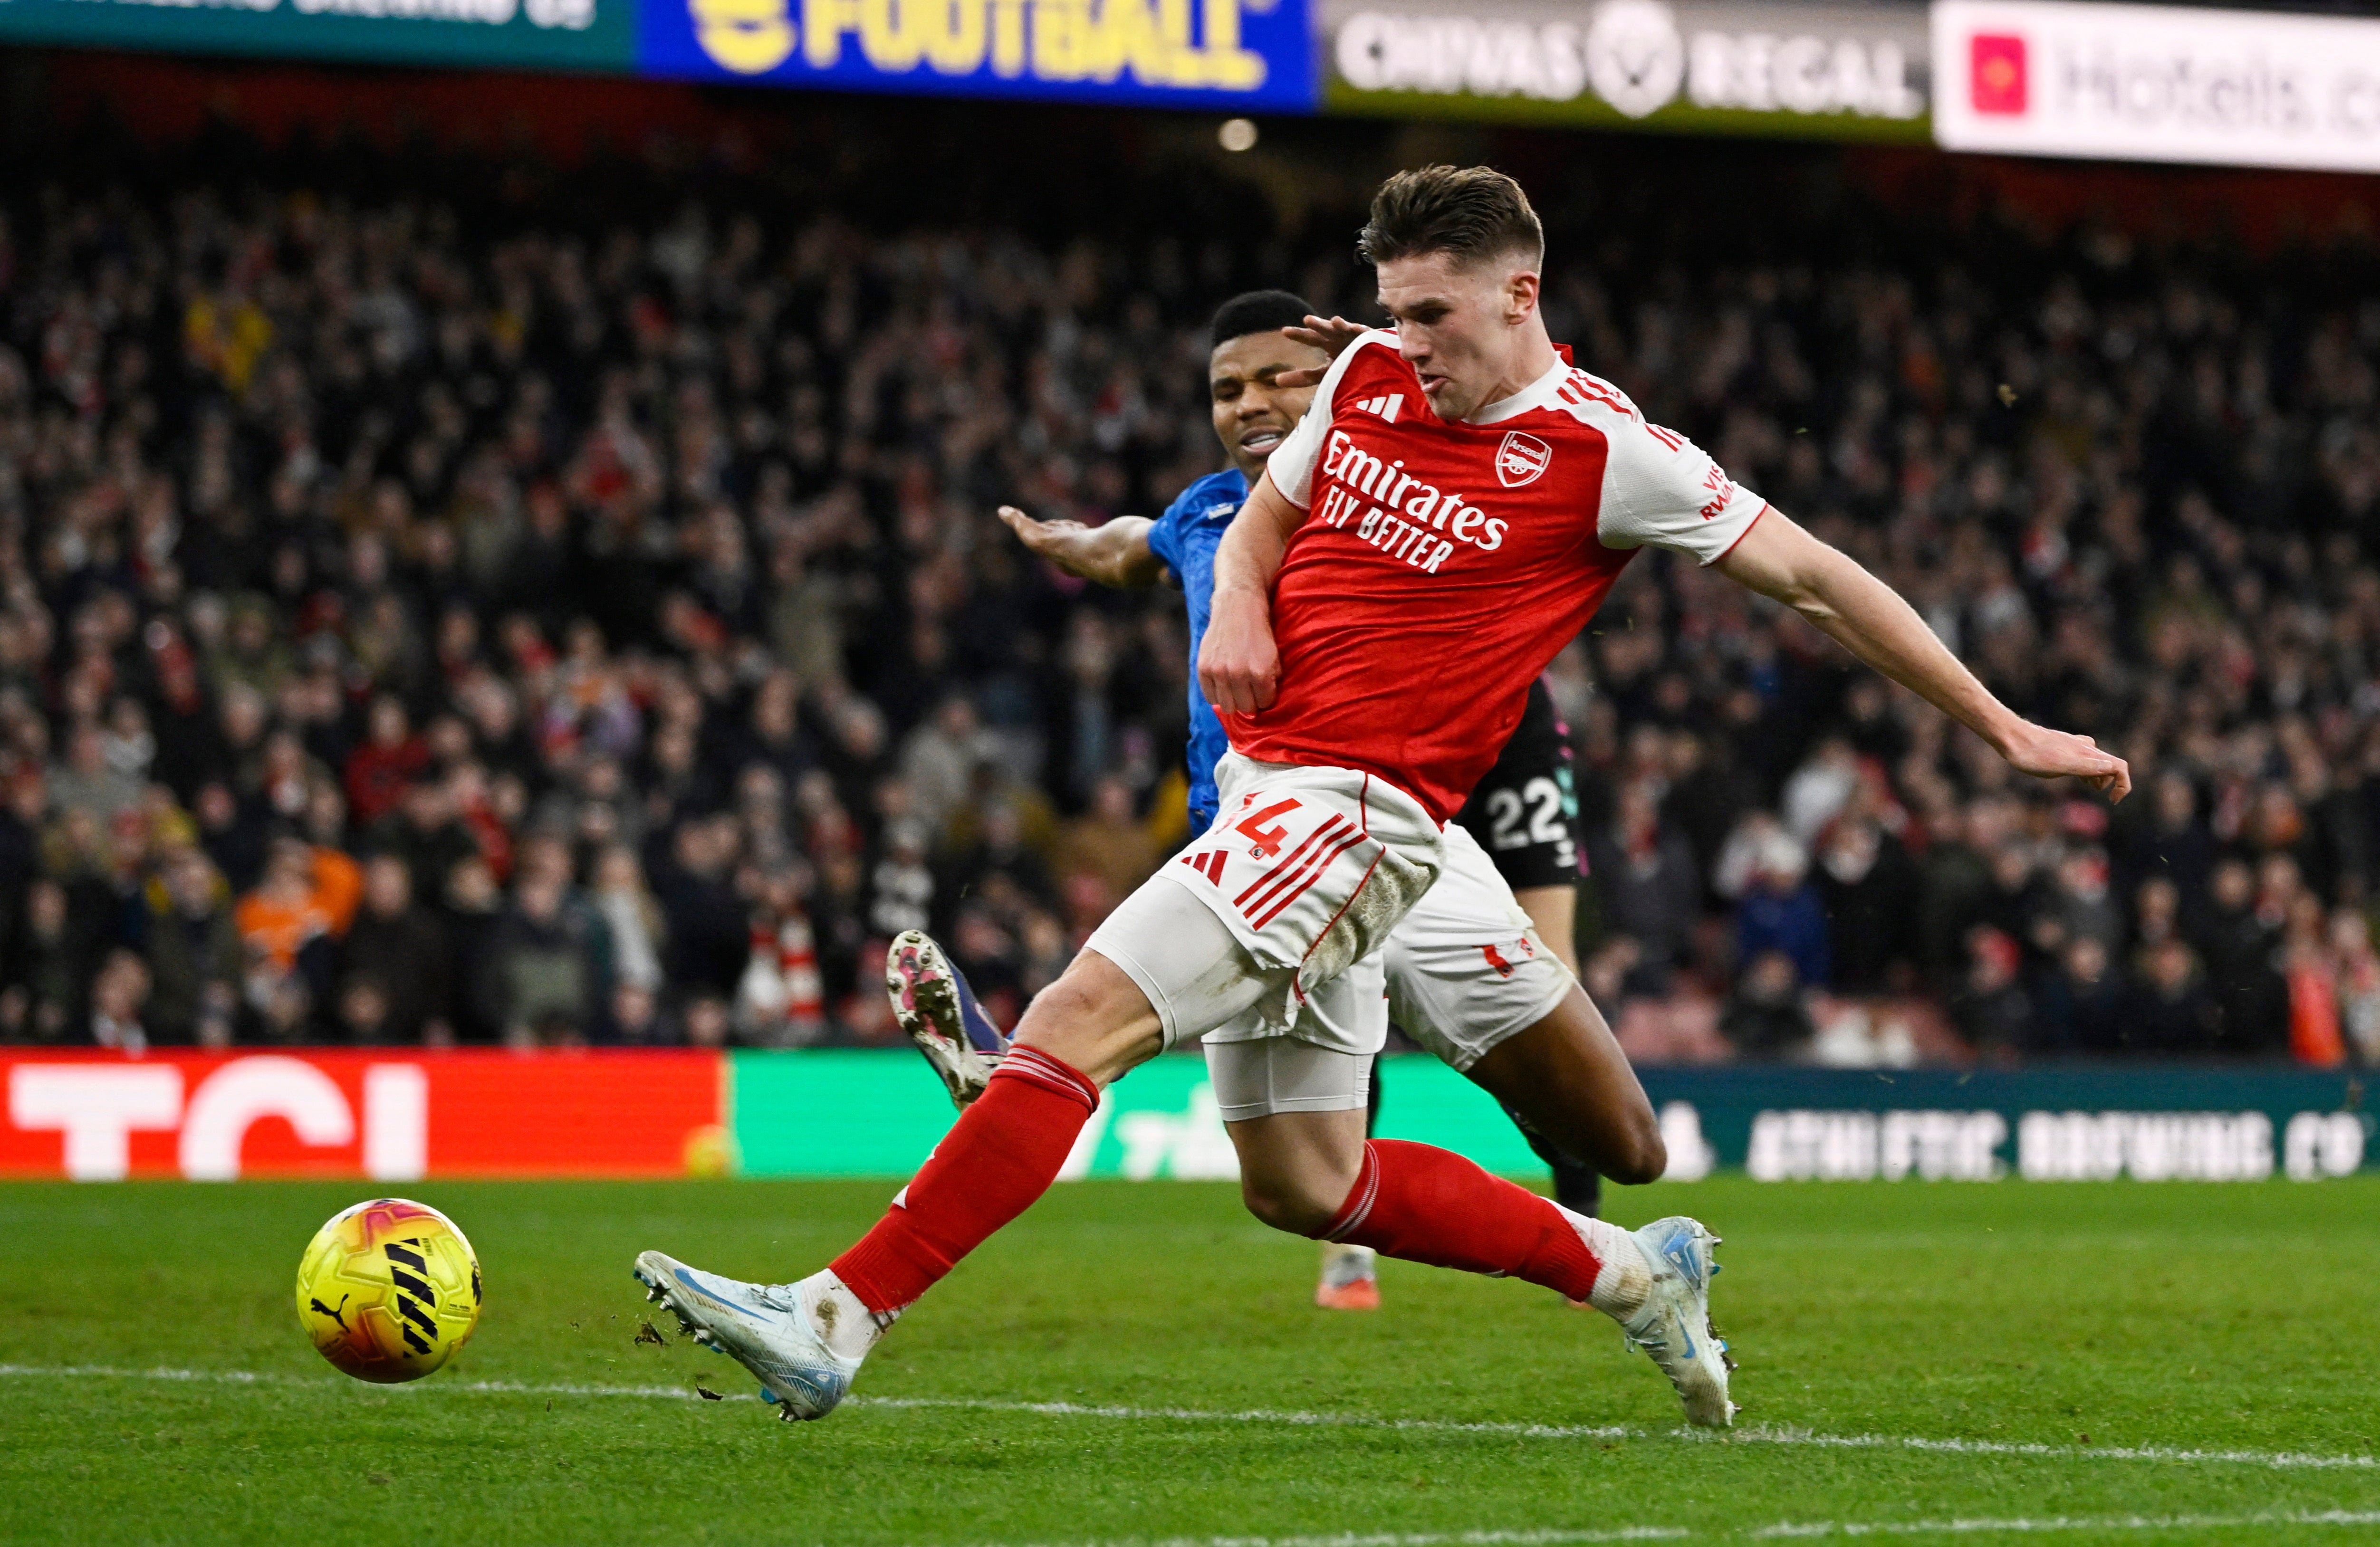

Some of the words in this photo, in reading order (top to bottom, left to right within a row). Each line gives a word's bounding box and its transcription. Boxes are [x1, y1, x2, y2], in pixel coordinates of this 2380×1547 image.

[1509, 440, 1545, 460] Arsenal
[1323, 430, 1509, 551] Emirates
[1700, 483, 1734, 521] RWA
[1321, 486, 1361, 529] FLY
[1356, 508, 1454, 574] BETTER
[1486, 776, 1567, 850] 22
